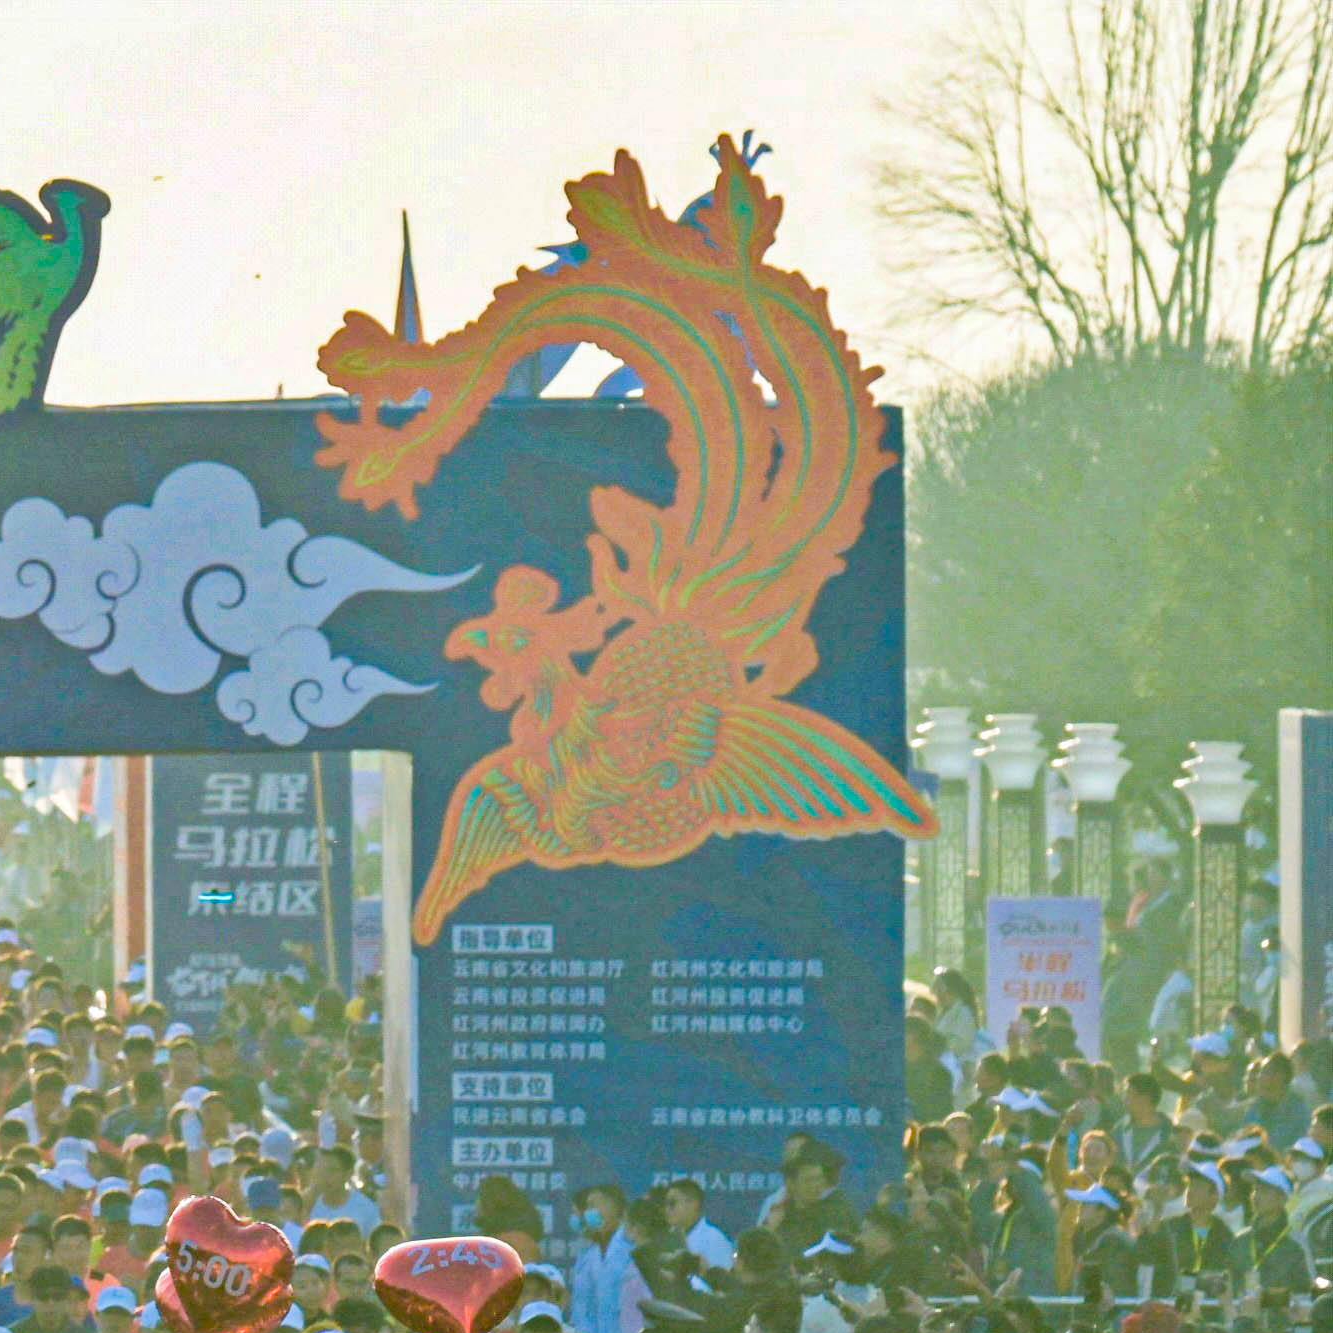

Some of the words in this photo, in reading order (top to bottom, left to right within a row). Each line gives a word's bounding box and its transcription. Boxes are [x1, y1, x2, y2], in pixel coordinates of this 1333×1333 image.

[201, 772, 309, 815] 全程
[174, 825, 335, 868] 马拉松
[459, 1142, 547, 1163] 主办单位
[177, 1240, 249, 1297] 5:00
[410, 1243, 504, 1275] 2:45
